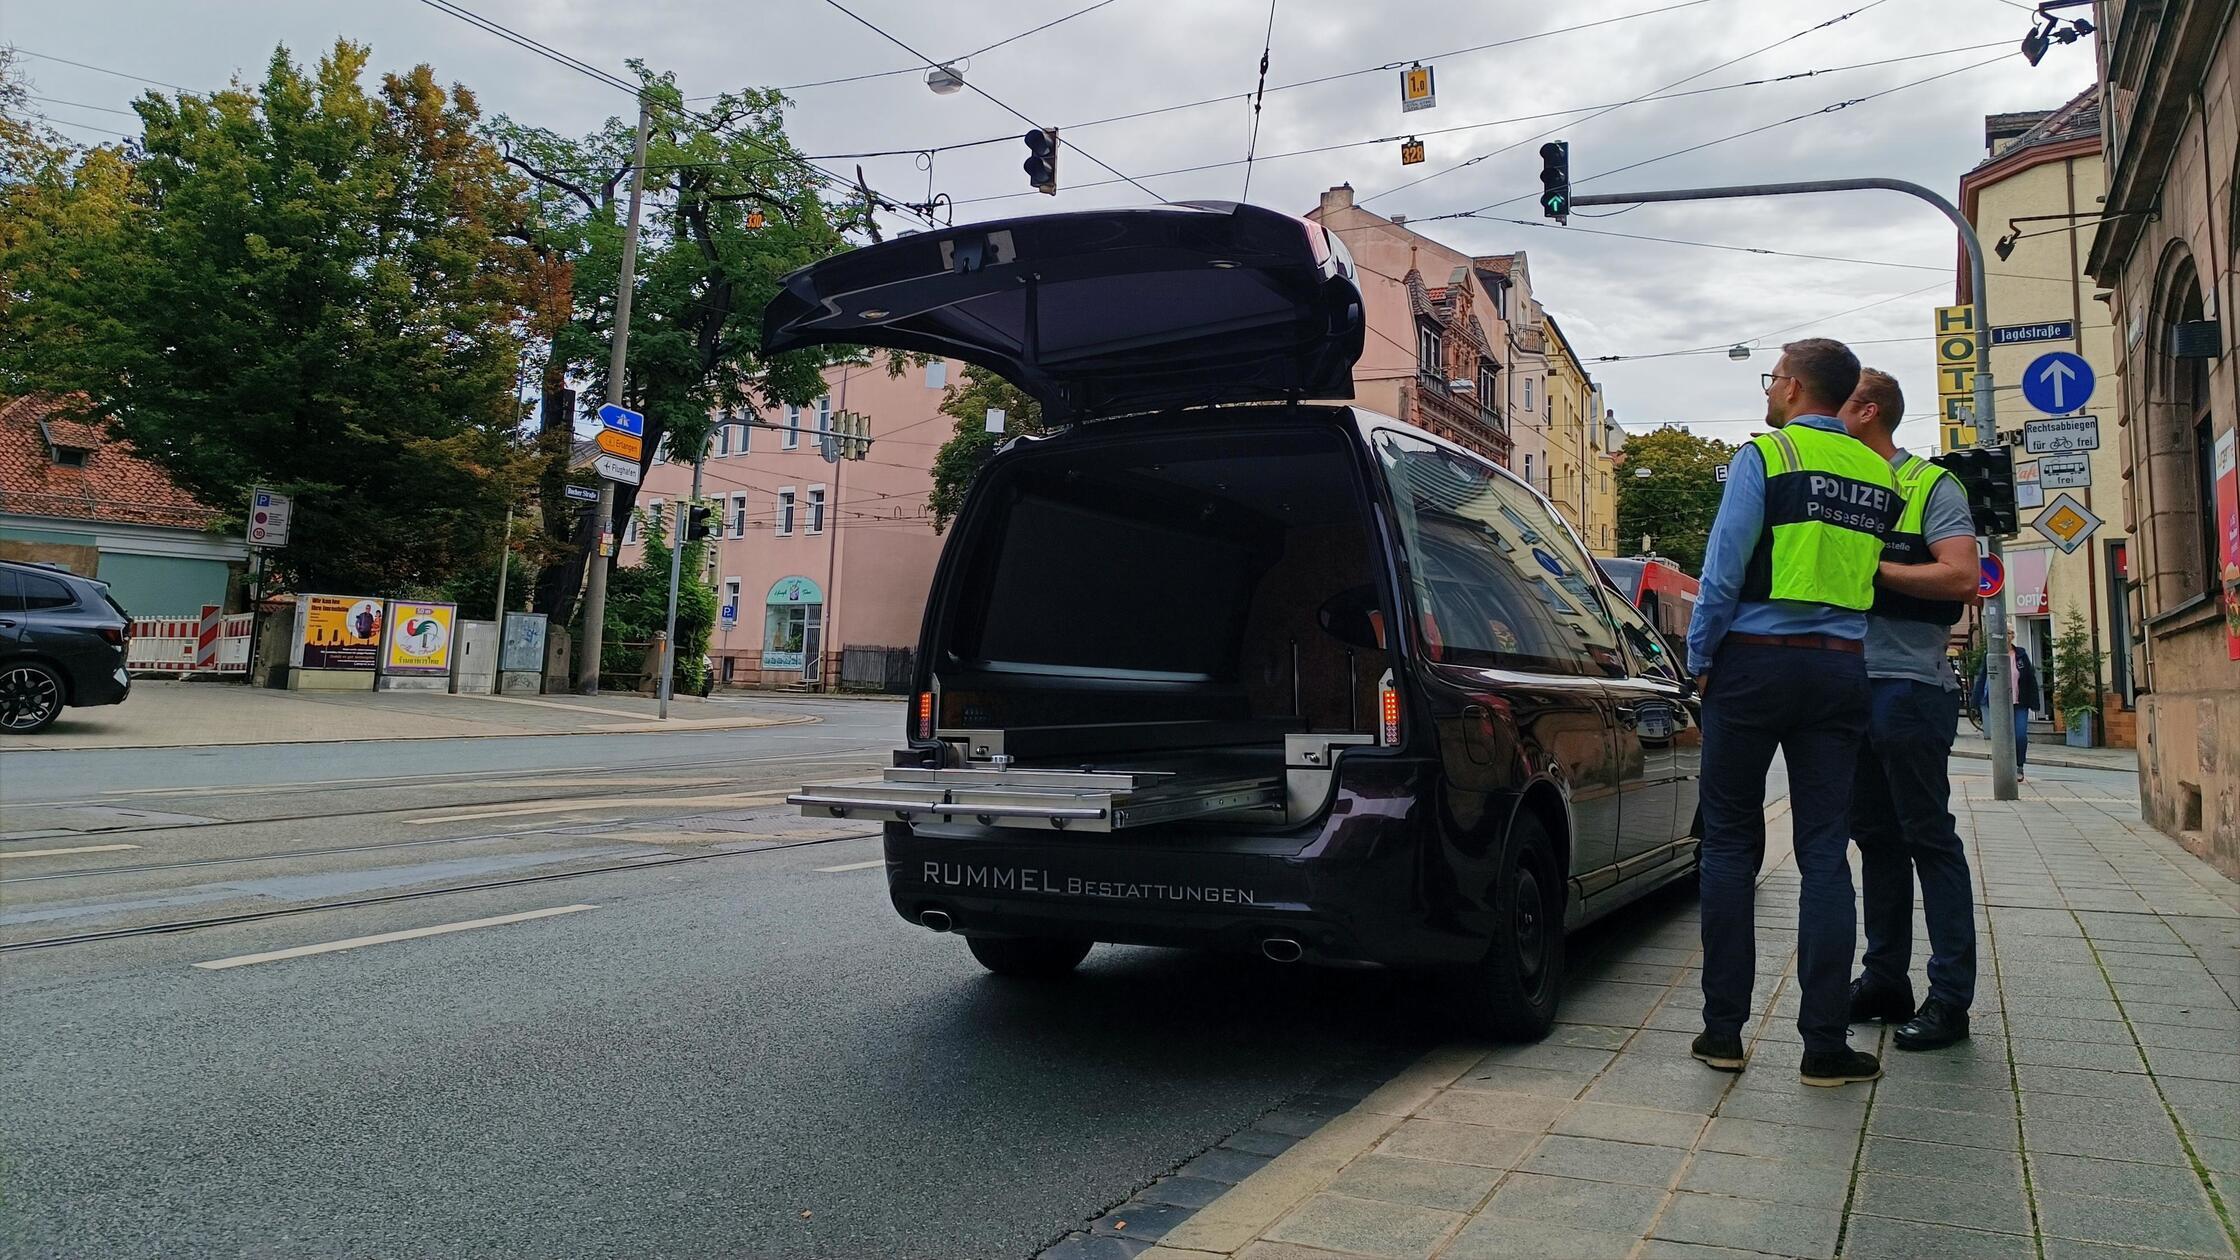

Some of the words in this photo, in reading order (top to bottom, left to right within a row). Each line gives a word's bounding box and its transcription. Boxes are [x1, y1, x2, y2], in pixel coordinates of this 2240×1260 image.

[1402, 146, 1424, 163] 328
[2001, 324, 2061, 342] Jagdstraße
[1940, 308, 1975, 450] HOTEL
[2026, 420, 2096, 433] Rechtsabbiegen
[615, 439, 638, 453] Erlangen
[2033, 440, 2046, 450] für
[2077, 436, 2093, 447] frei
[612, 463, 637, 476] Flughafen
[1717, 467, 1727, 480] E
[1809, 475, 1891, 512] POLIZEI
[1885, 541, 1911, 551] stelle
[923, 861, 1061, 893] RUMMEL
